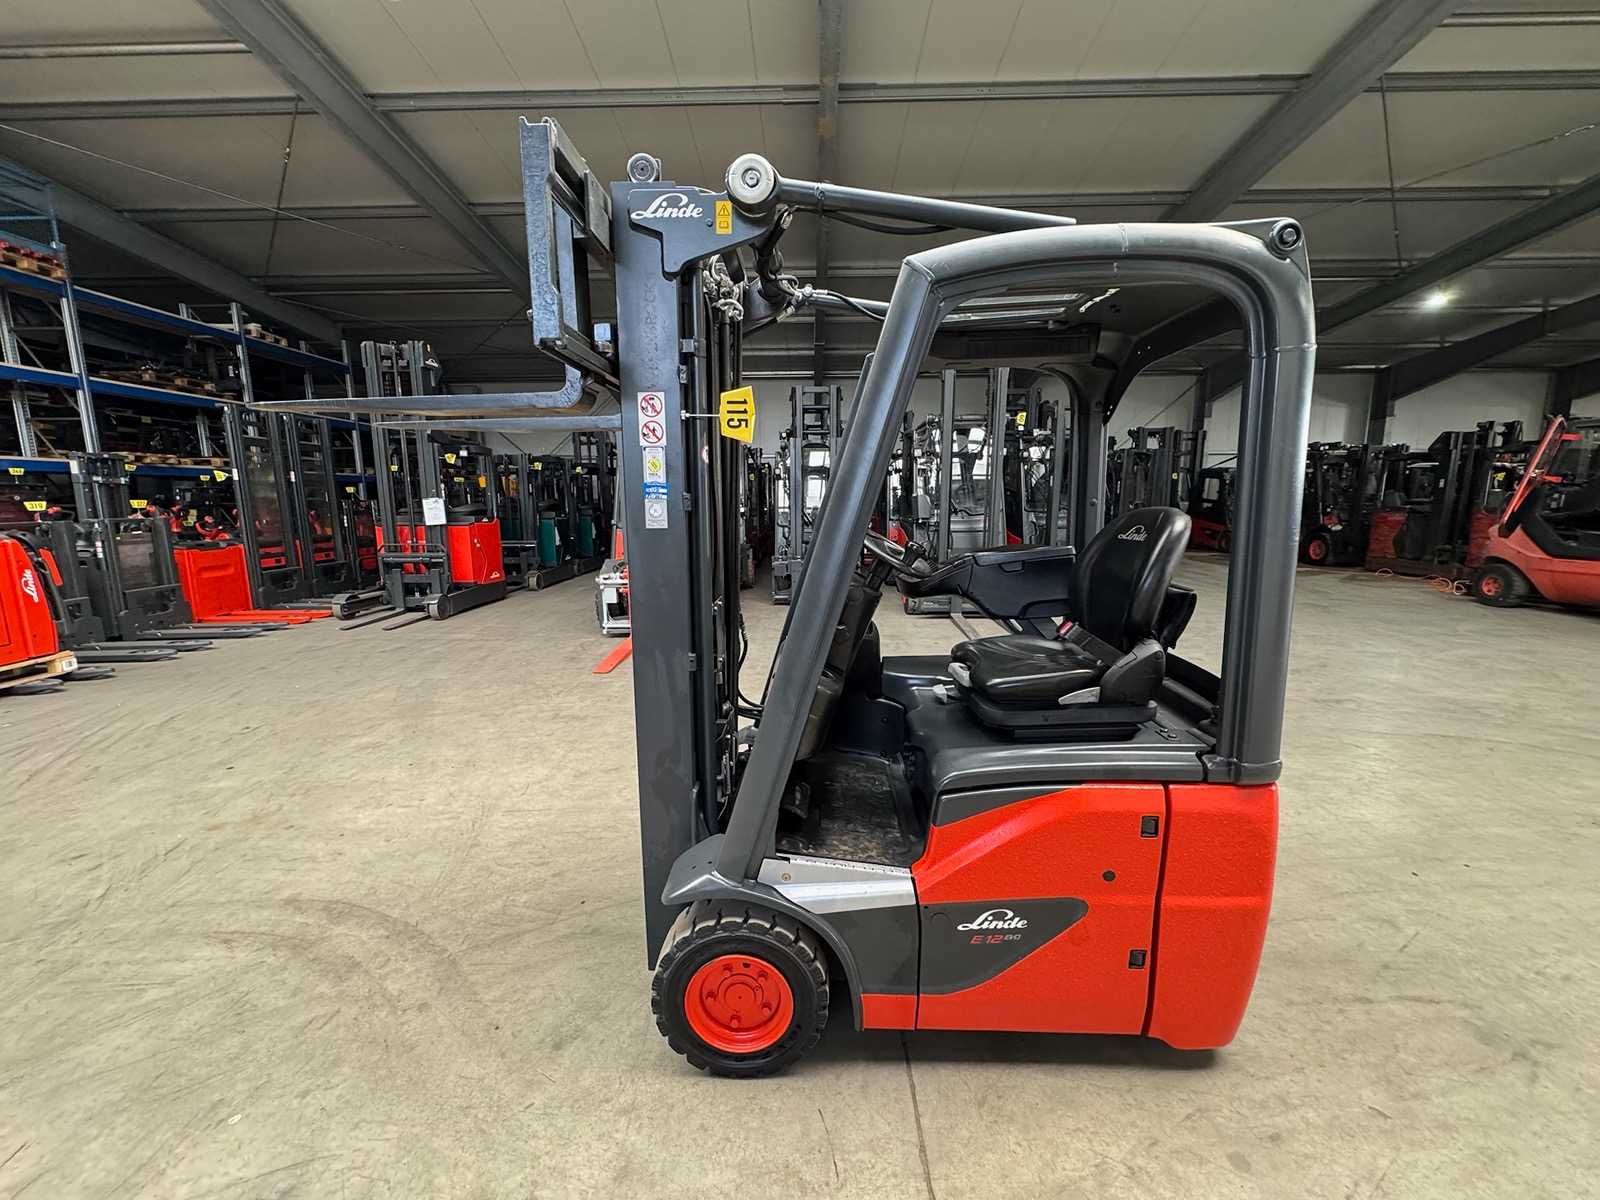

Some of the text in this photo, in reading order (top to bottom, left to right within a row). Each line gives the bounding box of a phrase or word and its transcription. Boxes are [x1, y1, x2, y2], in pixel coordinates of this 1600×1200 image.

[630, 193, 704, 219] Linde
[726, 398, 749, 429] 115
[957, 909, 1028, 930] Linde
